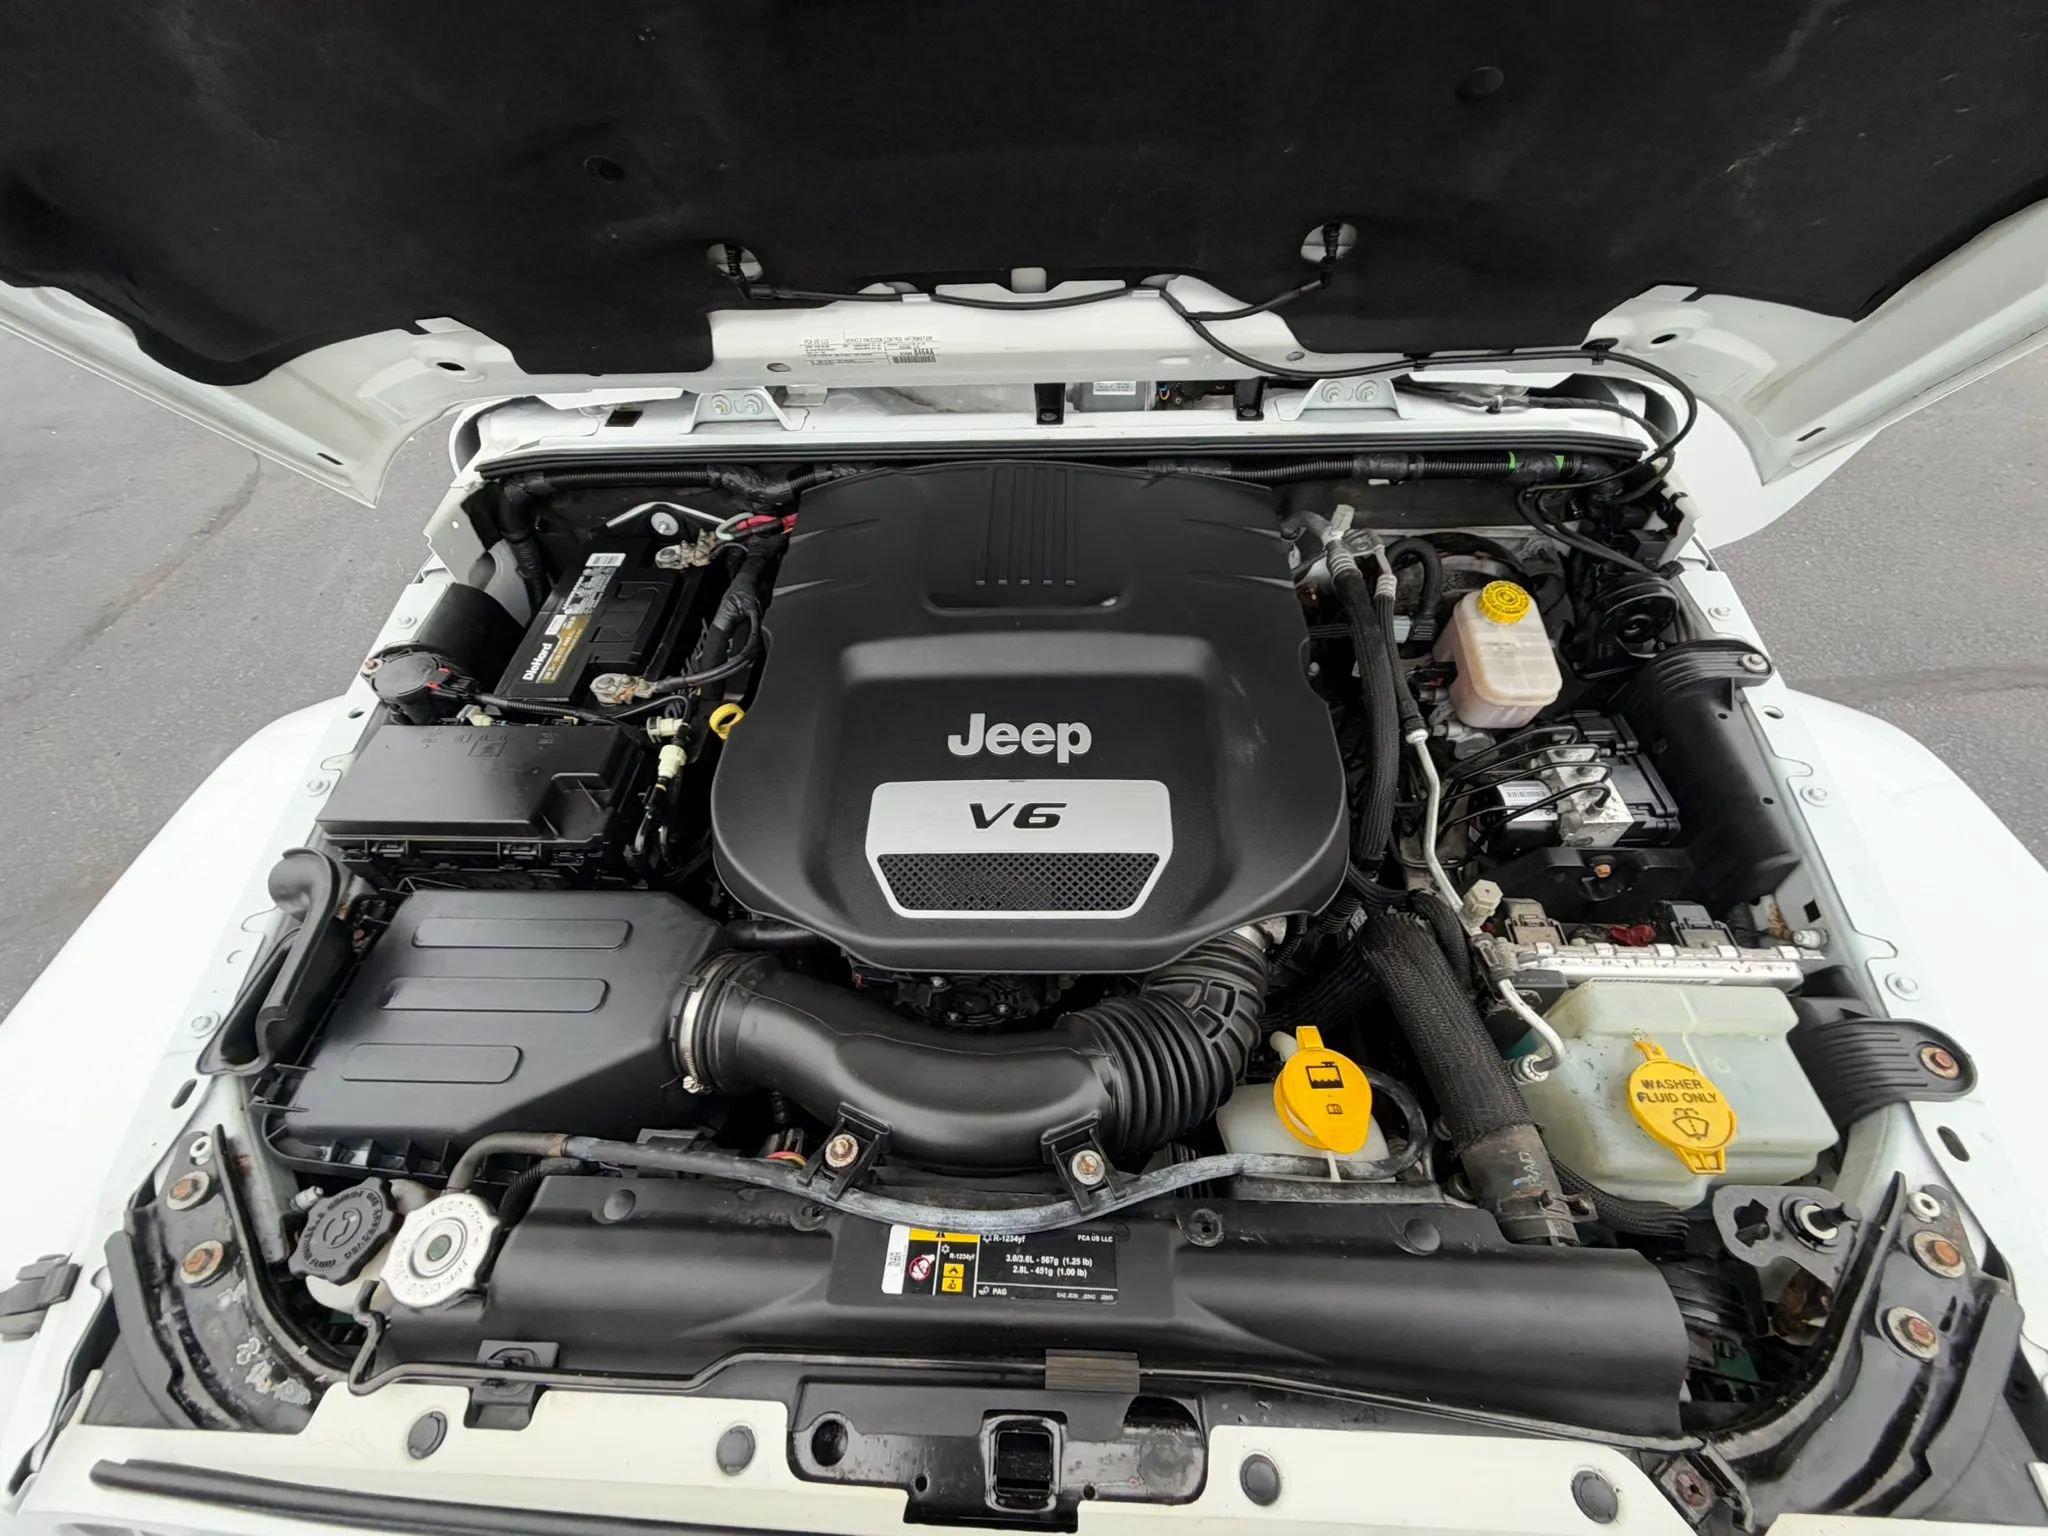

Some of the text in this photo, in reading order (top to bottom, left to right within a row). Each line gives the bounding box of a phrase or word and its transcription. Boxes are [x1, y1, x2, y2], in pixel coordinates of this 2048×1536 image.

[522, 643, 553, 680] DieHard
[948, 713, 1092, 763] Jeep
[969, 803, 1068, 829] V6
[1641, 1079, 1703, 1090] WASHER
[1637, 1092, 1717, 1103] FLUID ONLY
[993, 1235, 1026, 1244] R-1234yf
[1062, 1257, 1081, 1266] (1.25
[1082, 1258, 1092, 1267] lb)
[1012, 1265, 1029, 1274] 2.8L
[1035, 1267, 1053, 1277] 451g
[1057, 1268, 1076, 1277] (1.00
[1077, 1269, 1087, 1278] lb)
[992, 1287, 1007, 1295] PAG
